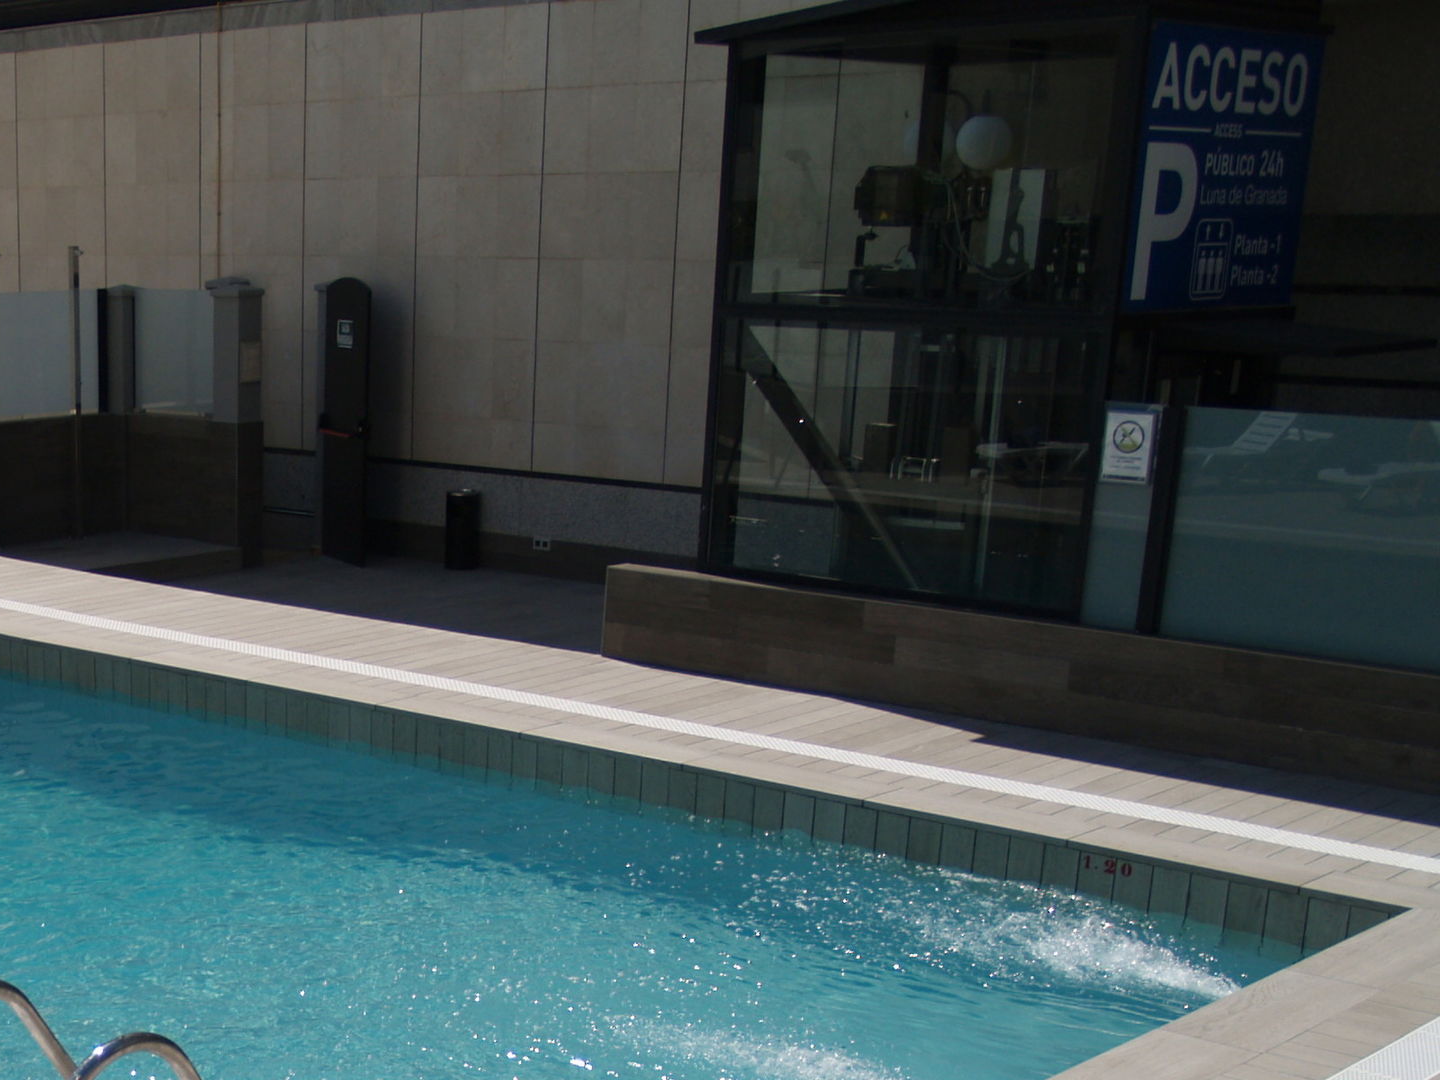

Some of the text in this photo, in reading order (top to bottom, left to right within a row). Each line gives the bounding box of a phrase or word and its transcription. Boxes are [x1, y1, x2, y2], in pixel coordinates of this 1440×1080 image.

[1152, 41, 1309, 117] ACCESO
[1214, 123, 1243, 138] ACCESS
[1204, 147, 1284, 178] PÚBLICO 24h
[1199, 184, 1288, 206] Luna de Granada
[1130, 141, 1198, 301] P
[1234, 234, 1282, 256] Planta -1
[1230, 264, 1279, 287] Planta -2
[1083, 855, 1133, 878] 1.20
